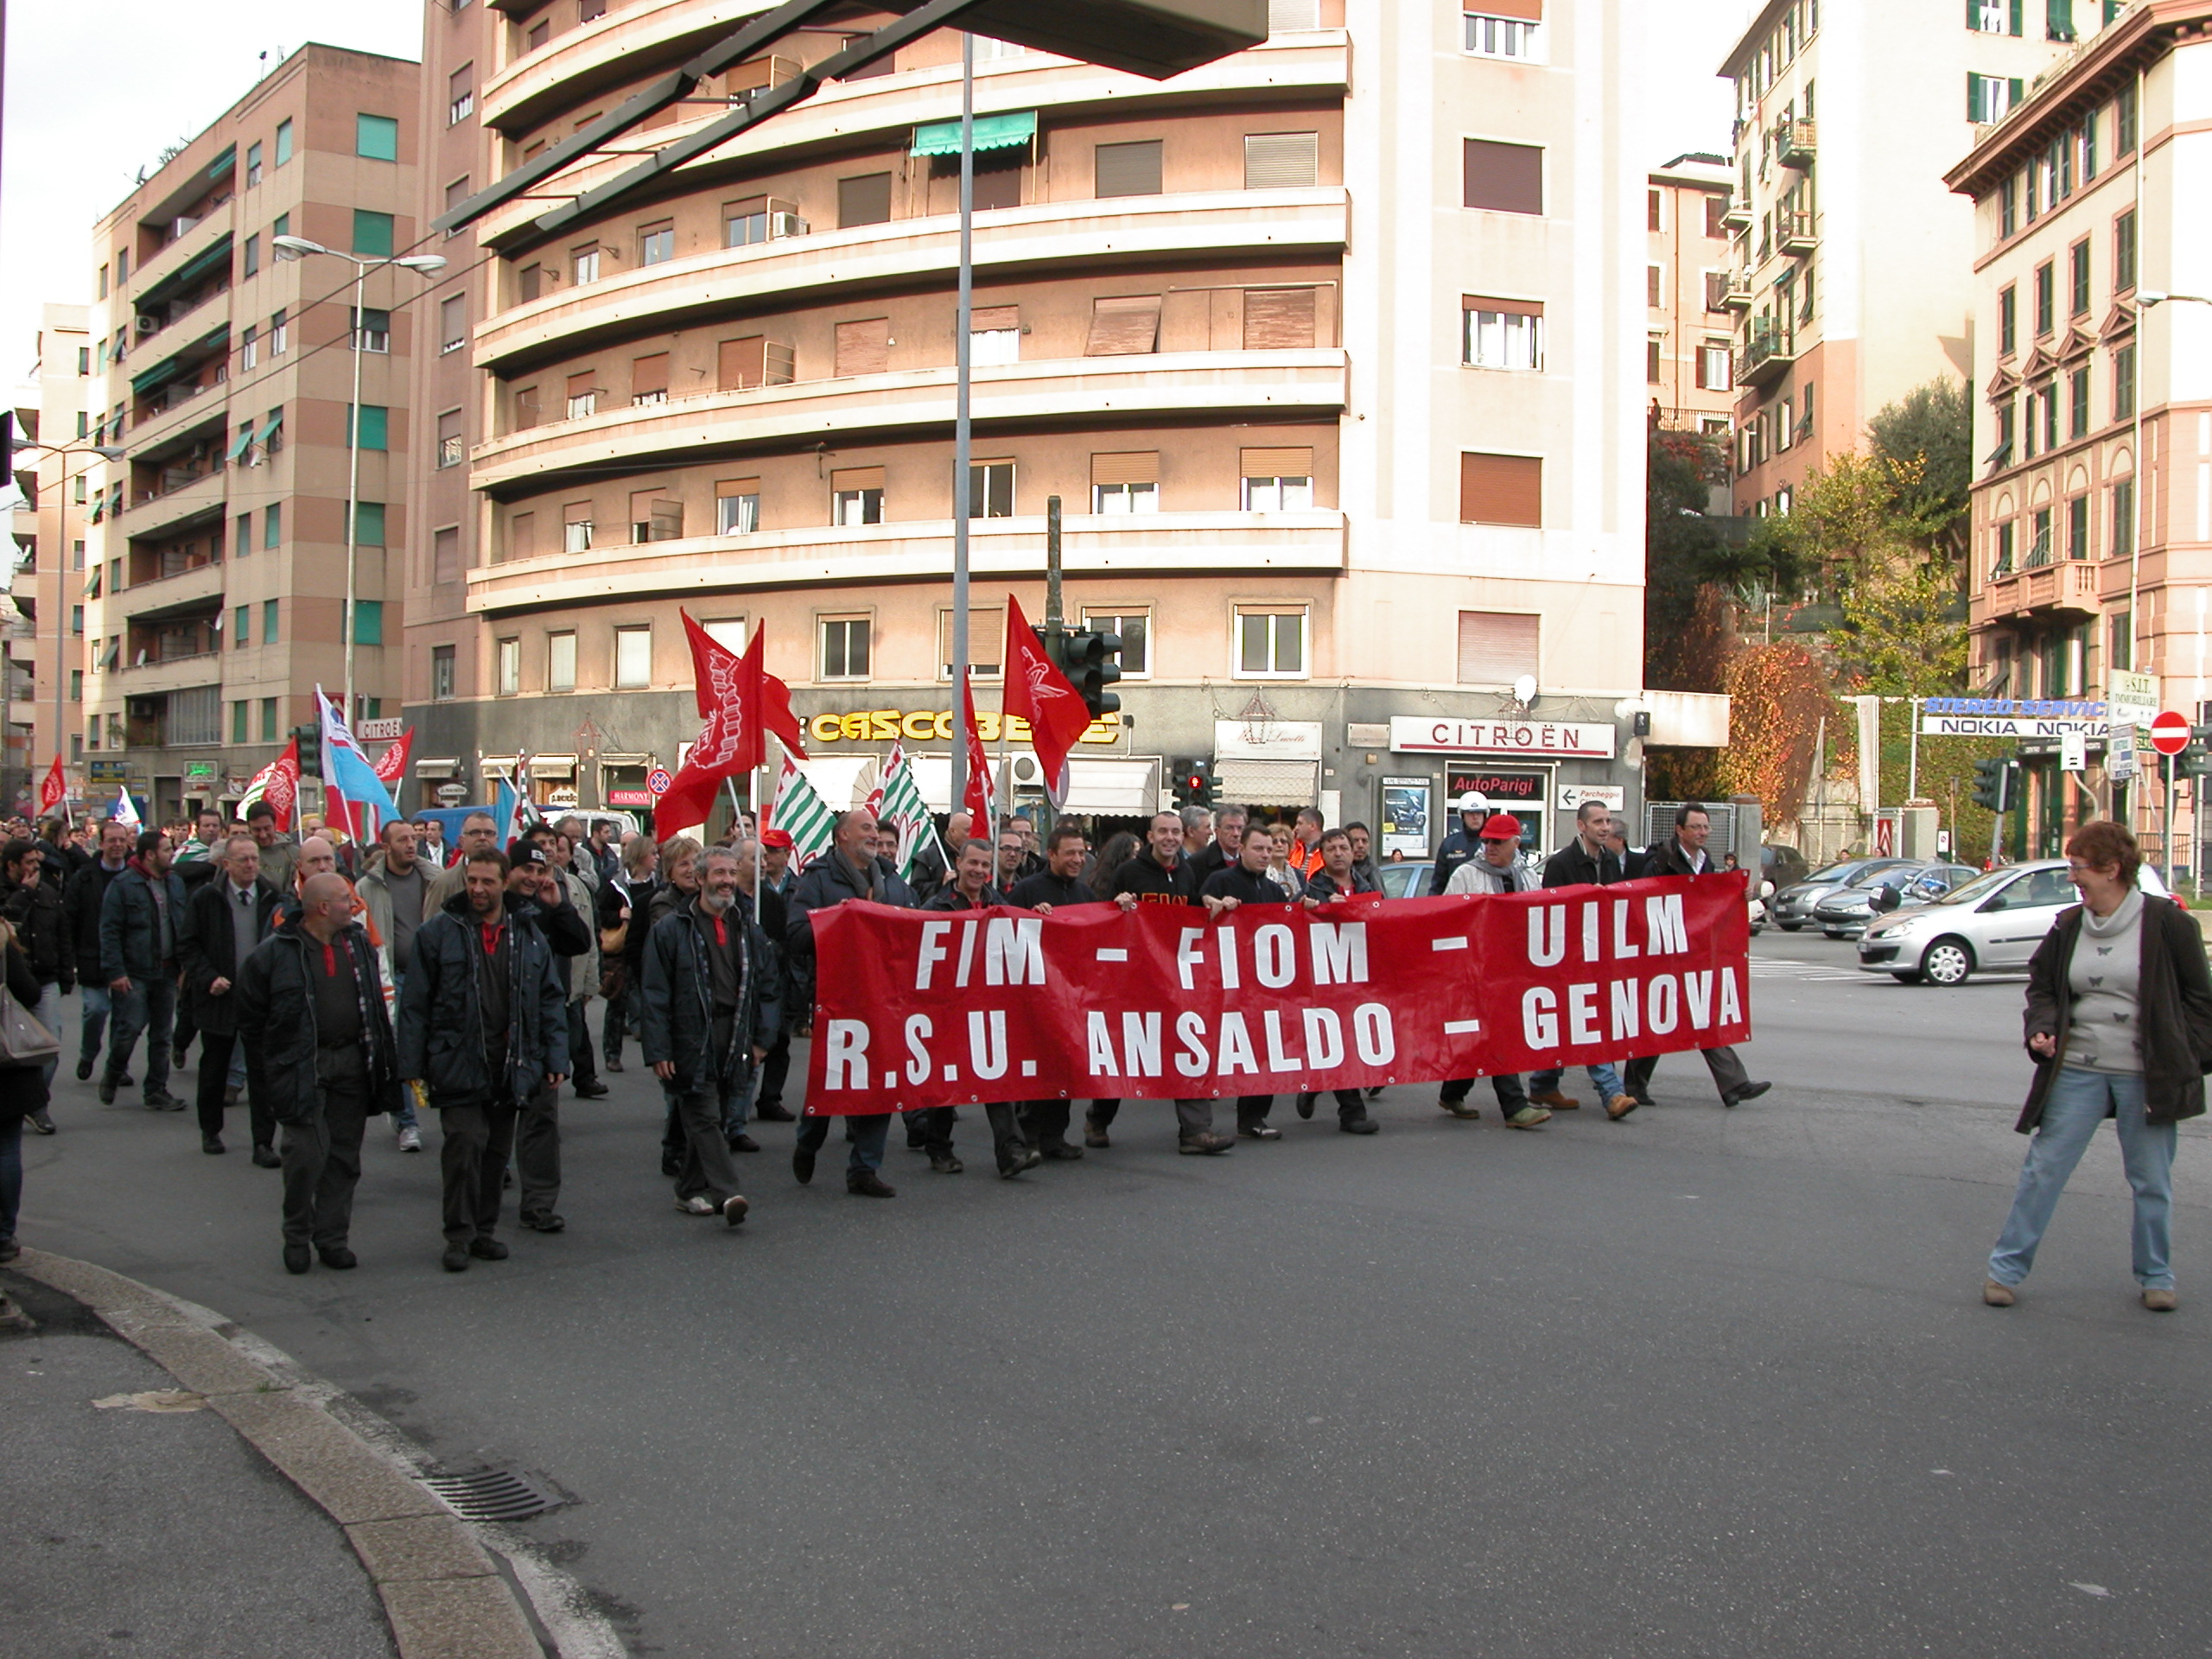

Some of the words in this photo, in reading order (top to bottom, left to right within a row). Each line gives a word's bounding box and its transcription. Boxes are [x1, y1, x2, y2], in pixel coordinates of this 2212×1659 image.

[1925, 696, 2014, 715] STEREO
[2021, 699, 2109, 717] SERVIC
[1432, 723, 1580, 748] CITROËN
[1941, 719, 2019, 734] NOKIA
[1454, 776, 1535, 796] AutoParigi
[1580, 790, 1620, 799] Parcheggio
[915, 917, 1046, 990] FIM
[1096, 947, 1128, 962] -
[1177, 921, 1369, 990] FIOM
[1432, 935, 1469, 952] -
[1527, 893, 1689, 967] UILM
[824, 1009, 1038, 1090] R.S.U.
[1087, 1002, 1396, 1078] ANSALDO
[1444, 1018, 1480, 1035] -
[1522, 965, 1743, 1051] GENOVA
